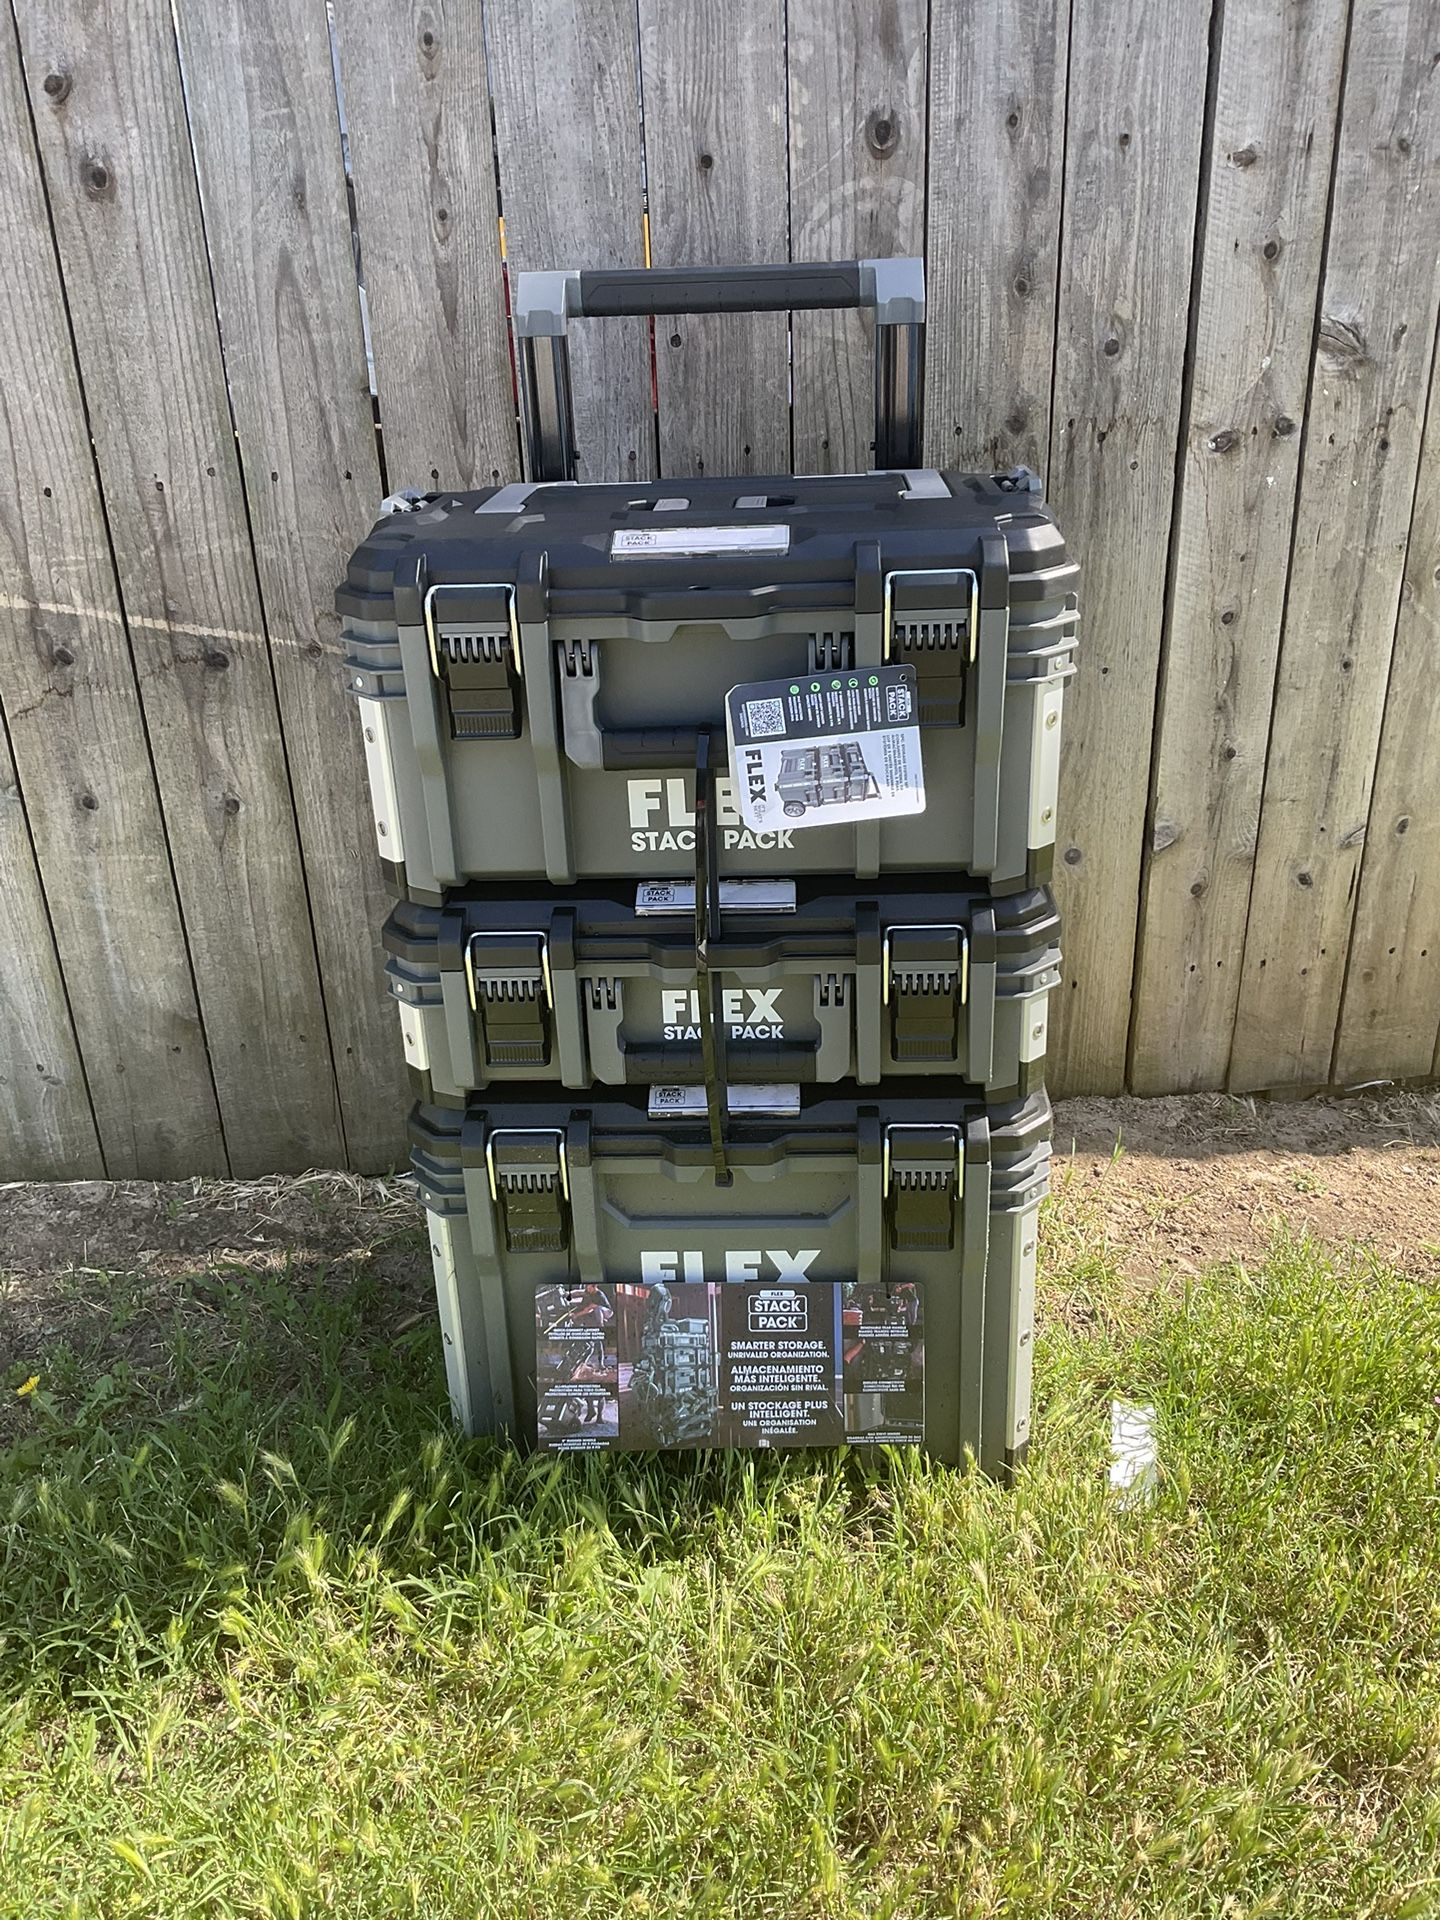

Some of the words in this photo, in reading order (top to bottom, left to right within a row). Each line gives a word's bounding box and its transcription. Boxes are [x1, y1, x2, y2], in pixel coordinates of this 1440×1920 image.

[888, 691, 896, 715] PACK
[897, 688, 906, 716] STACK
[745, 749, 766, 804] FLEX
[627, 777, 740, 828] FLE
[631, 830, 696, 851] STAC
[724, 830, 795, 850] PACK
[663, 1025, 702, 1040] STA
[731, 1025, 784, 1039] PACK
[754, 1300, 801, 1312] STACK
[731, 1341, 775, 1350] SMARTER
[778, 1341, 826, 1350] STORAGE.
[731, 1365, 824, 1374] ALMACENAMIENTO
[734, 1373, 756, 1383] MÁS
[759, 1374, 821, 1383] INTELIGENTE.
[730, 1384, 789, 1392] ORGANIZACIÓN
[731, 1402, 745, 1410] UN
[748, 1401, 802, 1410] STOCKAGE
[805, 1401, 828, 1409] PLUS
[749, 1410, 810, 1418] INTELLIGENT.
